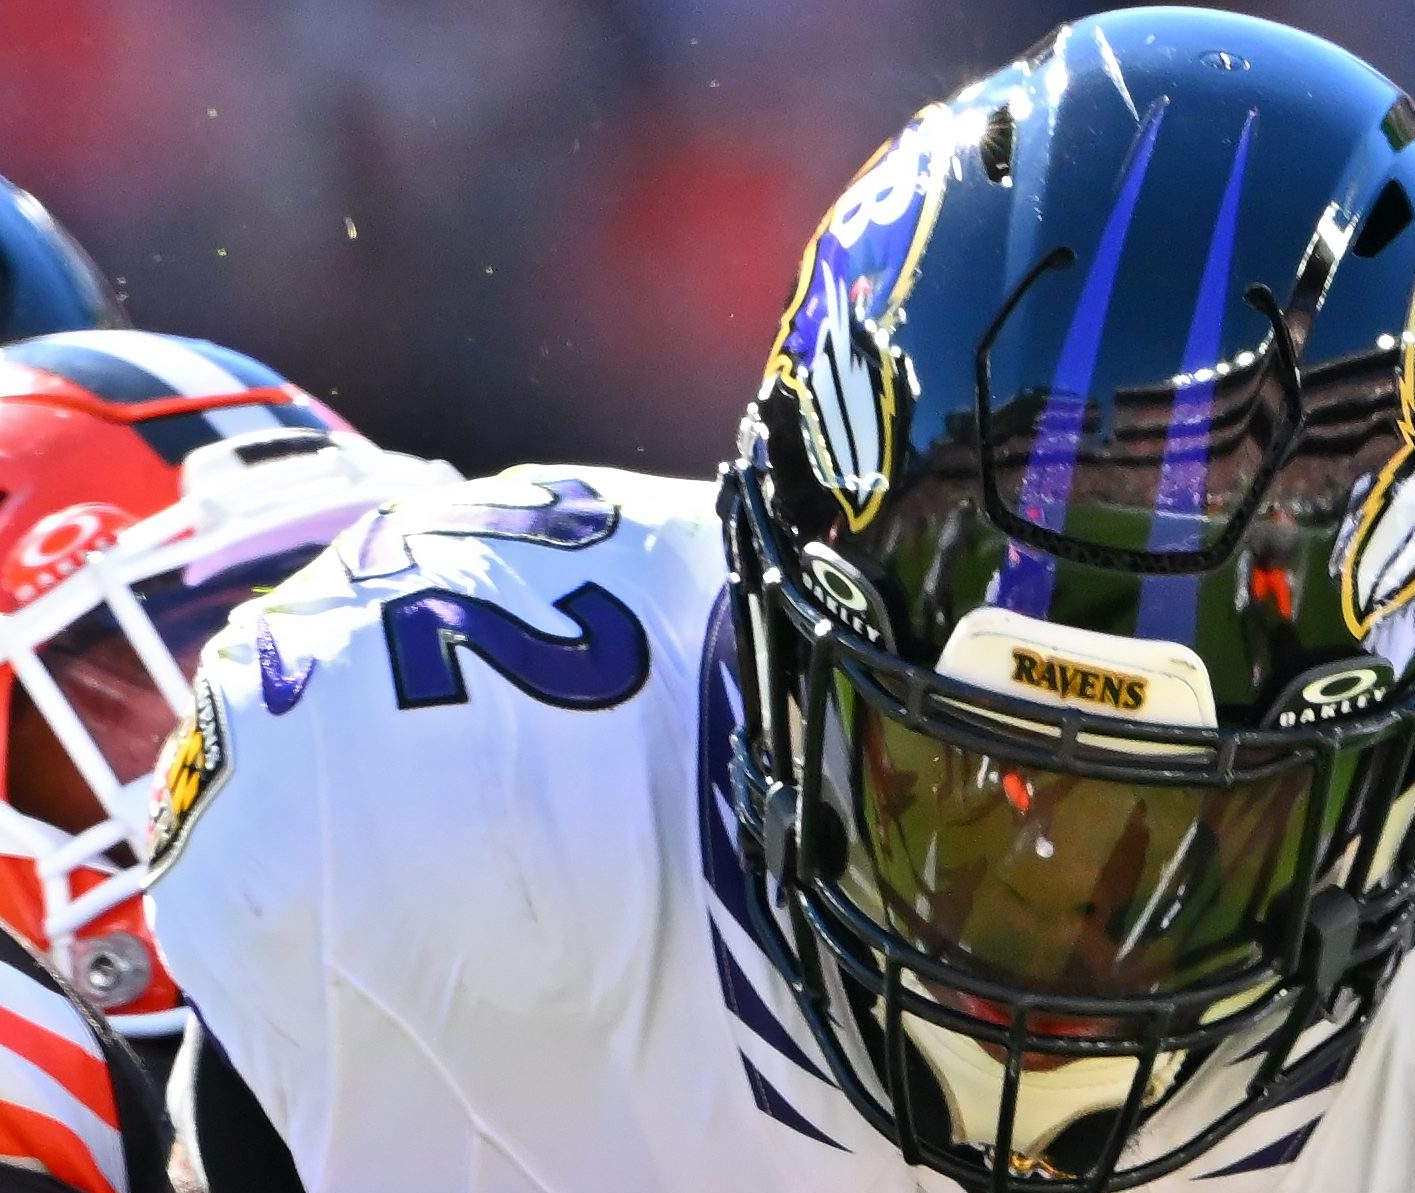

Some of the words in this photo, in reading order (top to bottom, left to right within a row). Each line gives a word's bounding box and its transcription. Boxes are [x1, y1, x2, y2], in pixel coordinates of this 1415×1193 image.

[801, 571, 882, 643] OAKLEY
[1011, 647, 1149, 711] RAVENS
[1279, 686, 1387, 727] OAKLEY
